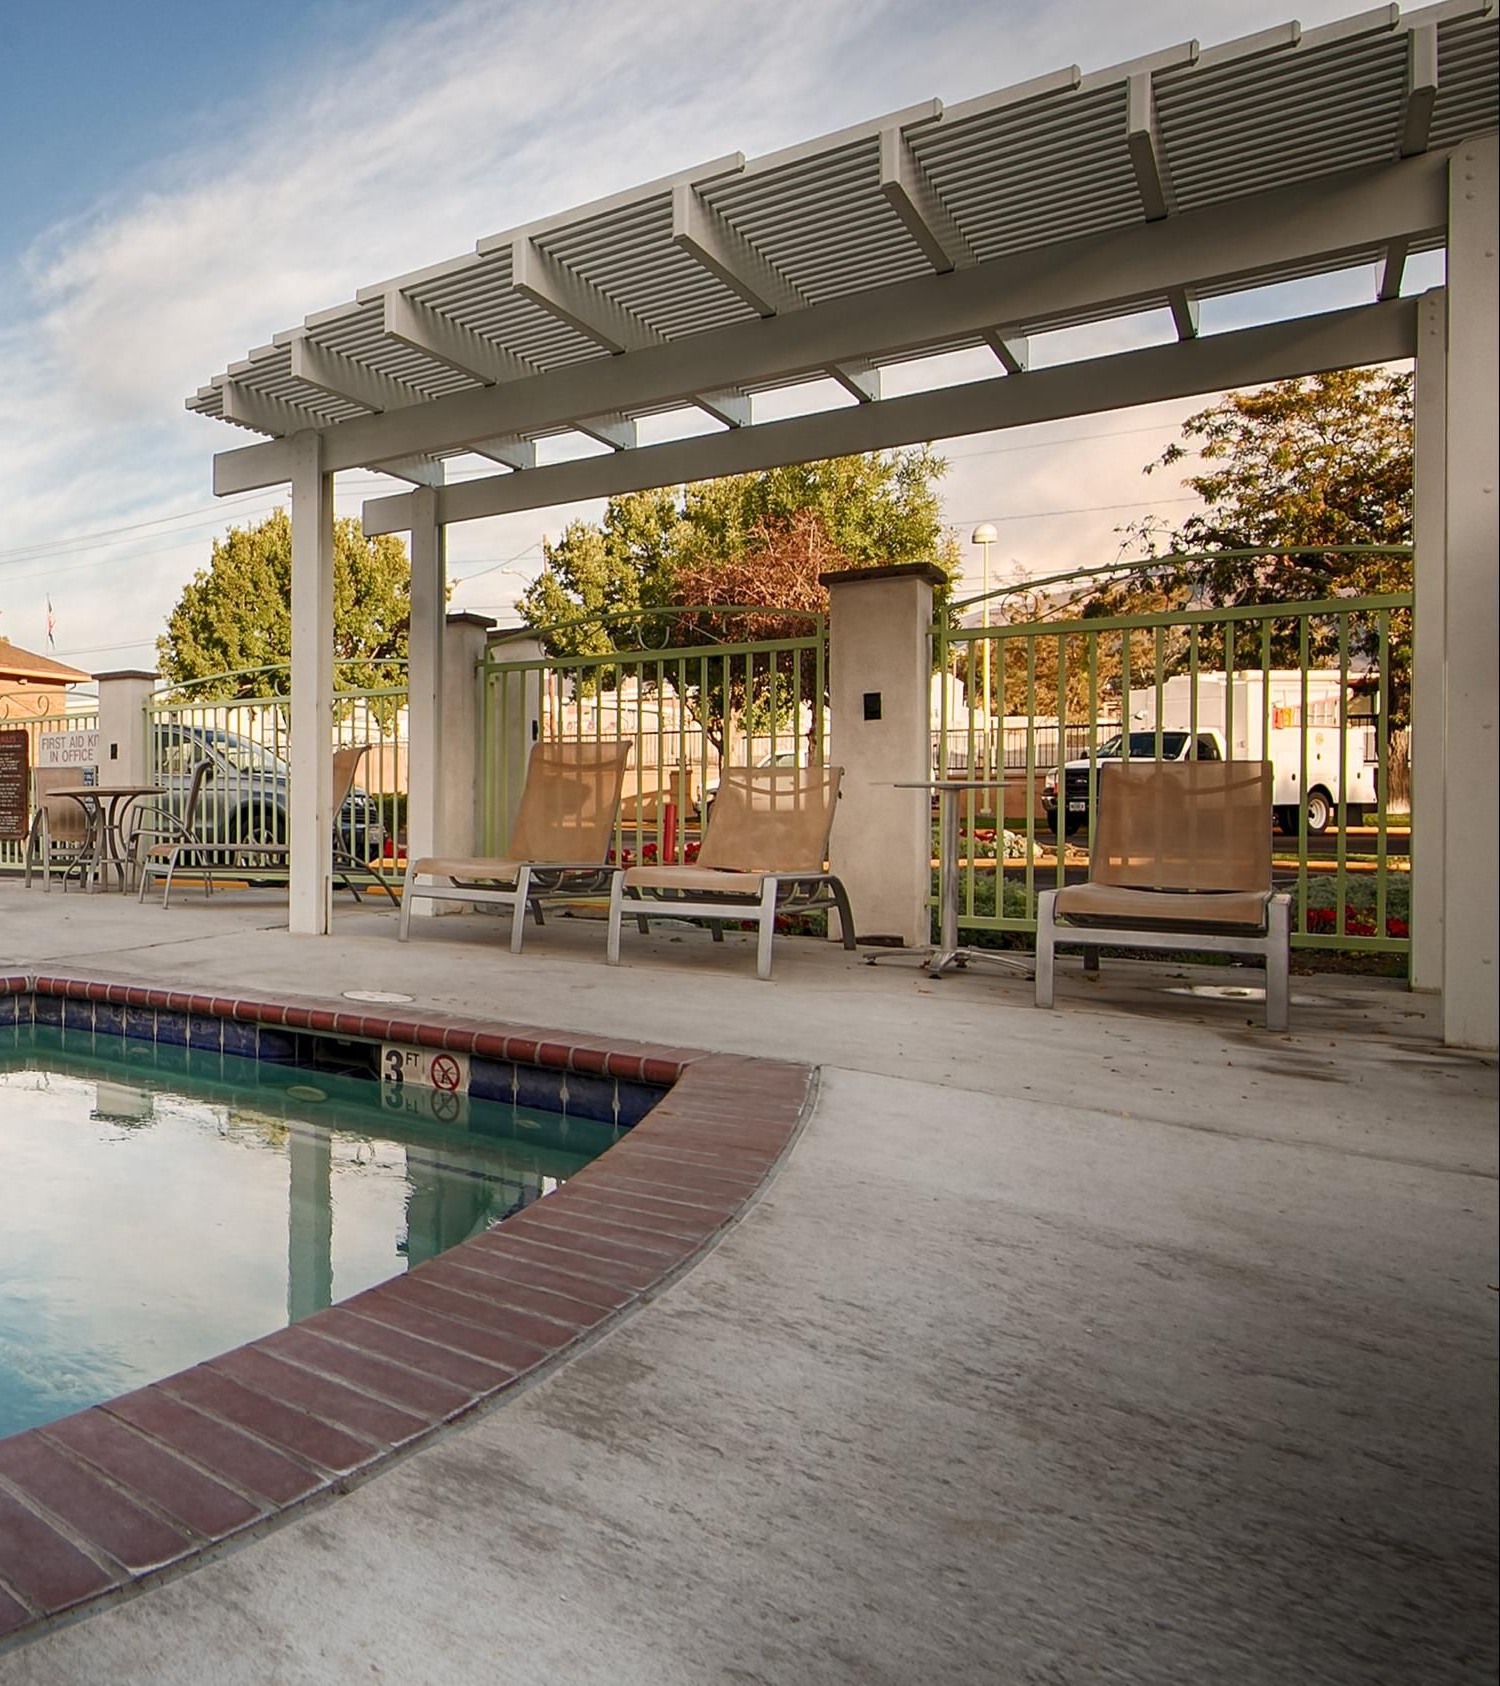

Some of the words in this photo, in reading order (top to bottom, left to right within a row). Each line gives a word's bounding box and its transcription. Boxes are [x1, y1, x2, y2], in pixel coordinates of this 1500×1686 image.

[41, 737, 66, 750] FIRST
[69, 735, 85, 748] AID
[50, 750, 59, 762] IN
[61, 748, 94, 762] OFFICE
[385, 1049, 404, 1083] 3
[405, 1052, 419, 1067] FT
